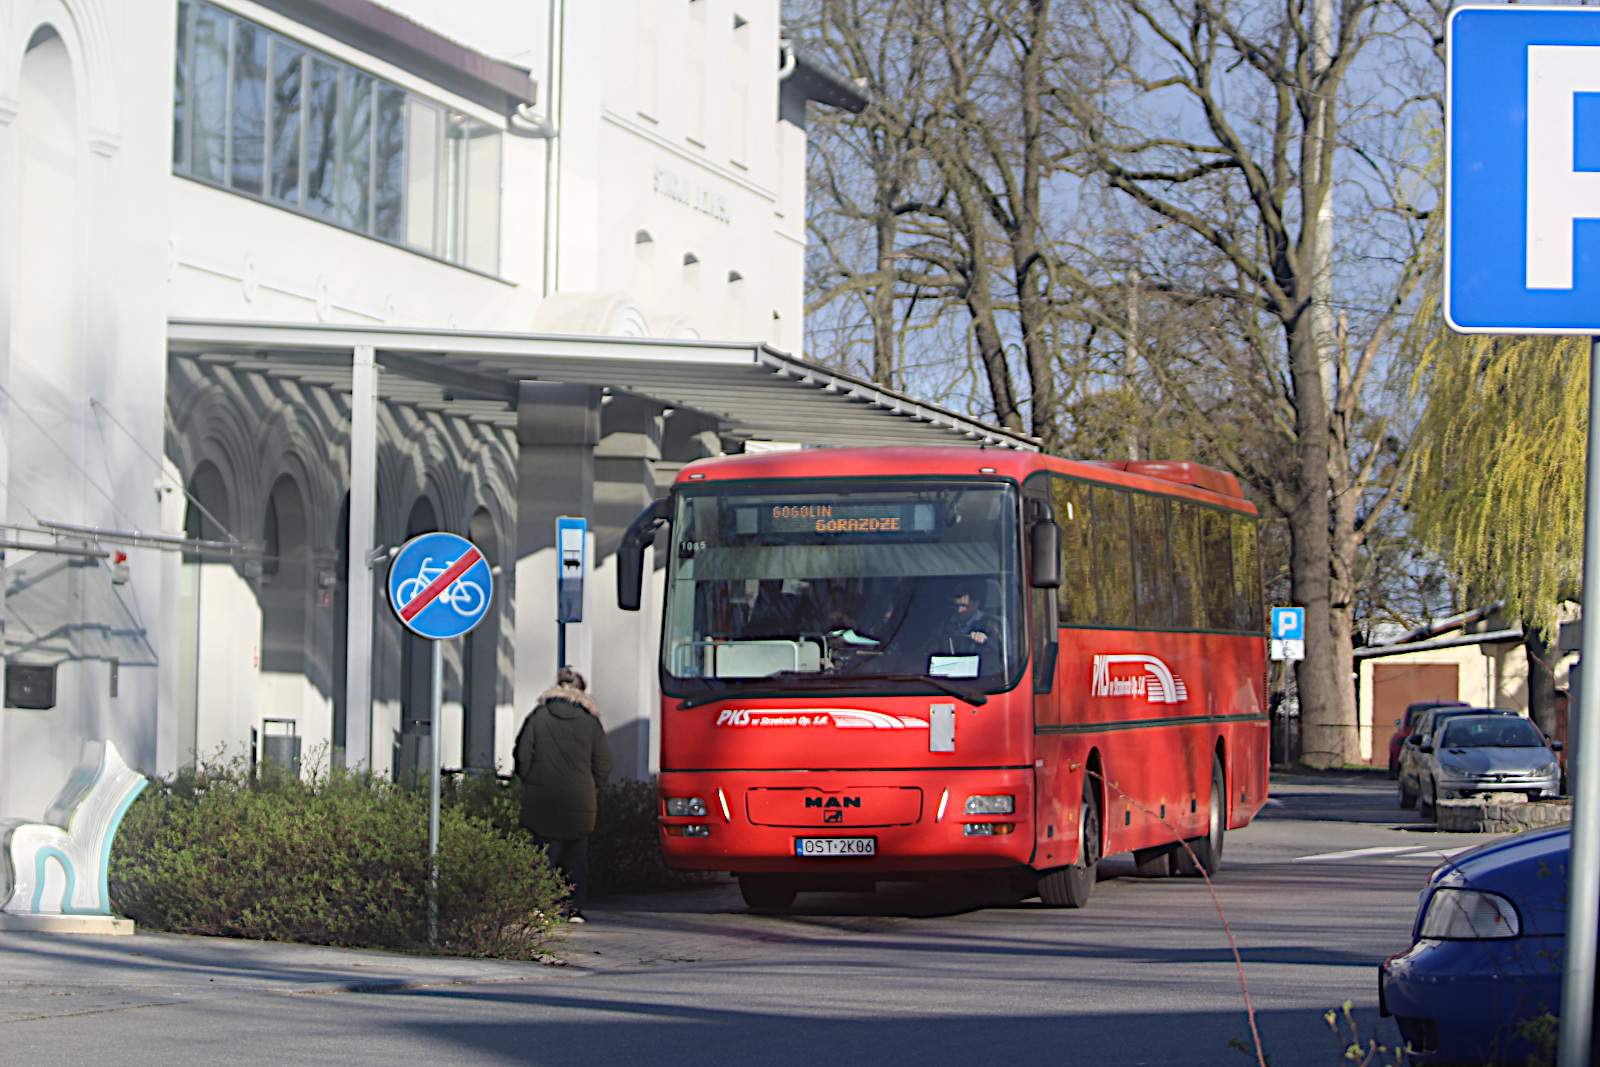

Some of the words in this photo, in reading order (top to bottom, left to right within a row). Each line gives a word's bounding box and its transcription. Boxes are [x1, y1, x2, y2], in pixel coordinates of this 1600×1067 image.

[772, 505, 832, 518] GOGOLIN
[681, 541, 706, 551] 1085
[1278, 611, 1297, 637] P
[716, 709, 750, 725] PKS
[805, 797, 861, 808] MAN
[805, 840, 834, 853] OST
[839, 840, 873, 853] 2K06
